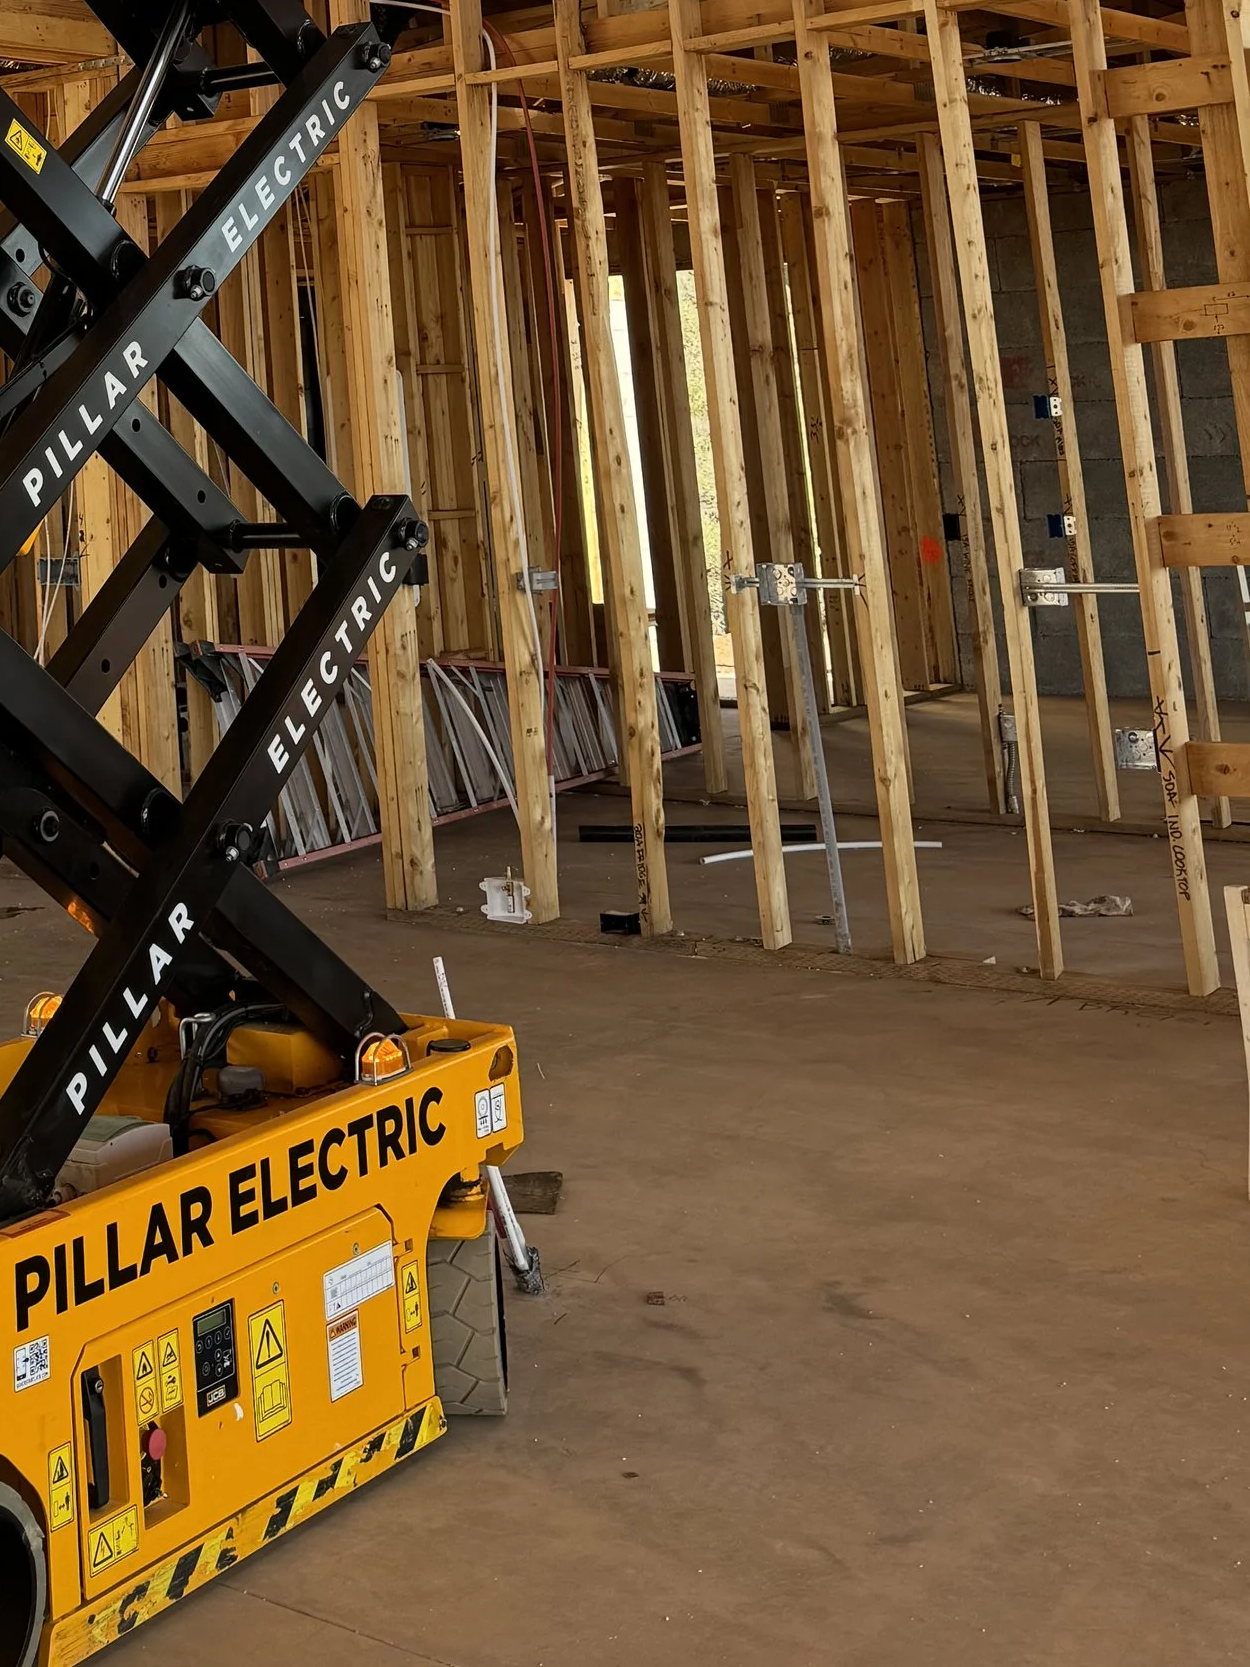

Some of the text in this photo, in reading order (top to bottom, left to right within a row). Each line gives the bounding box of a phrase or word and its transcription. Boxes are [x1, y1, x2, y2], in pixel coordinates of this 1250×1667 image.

[22, 81, 350, 507] PILLAR ELECTRIC
[65, 551, 397, 1116] PILLAR ELECTRIC
[16, 1087, 447, 1332] PILLAR ELECTRIC
[335, 1316, 357, 1335] WARNING
[208, 1389, 225, 1405] JCB
